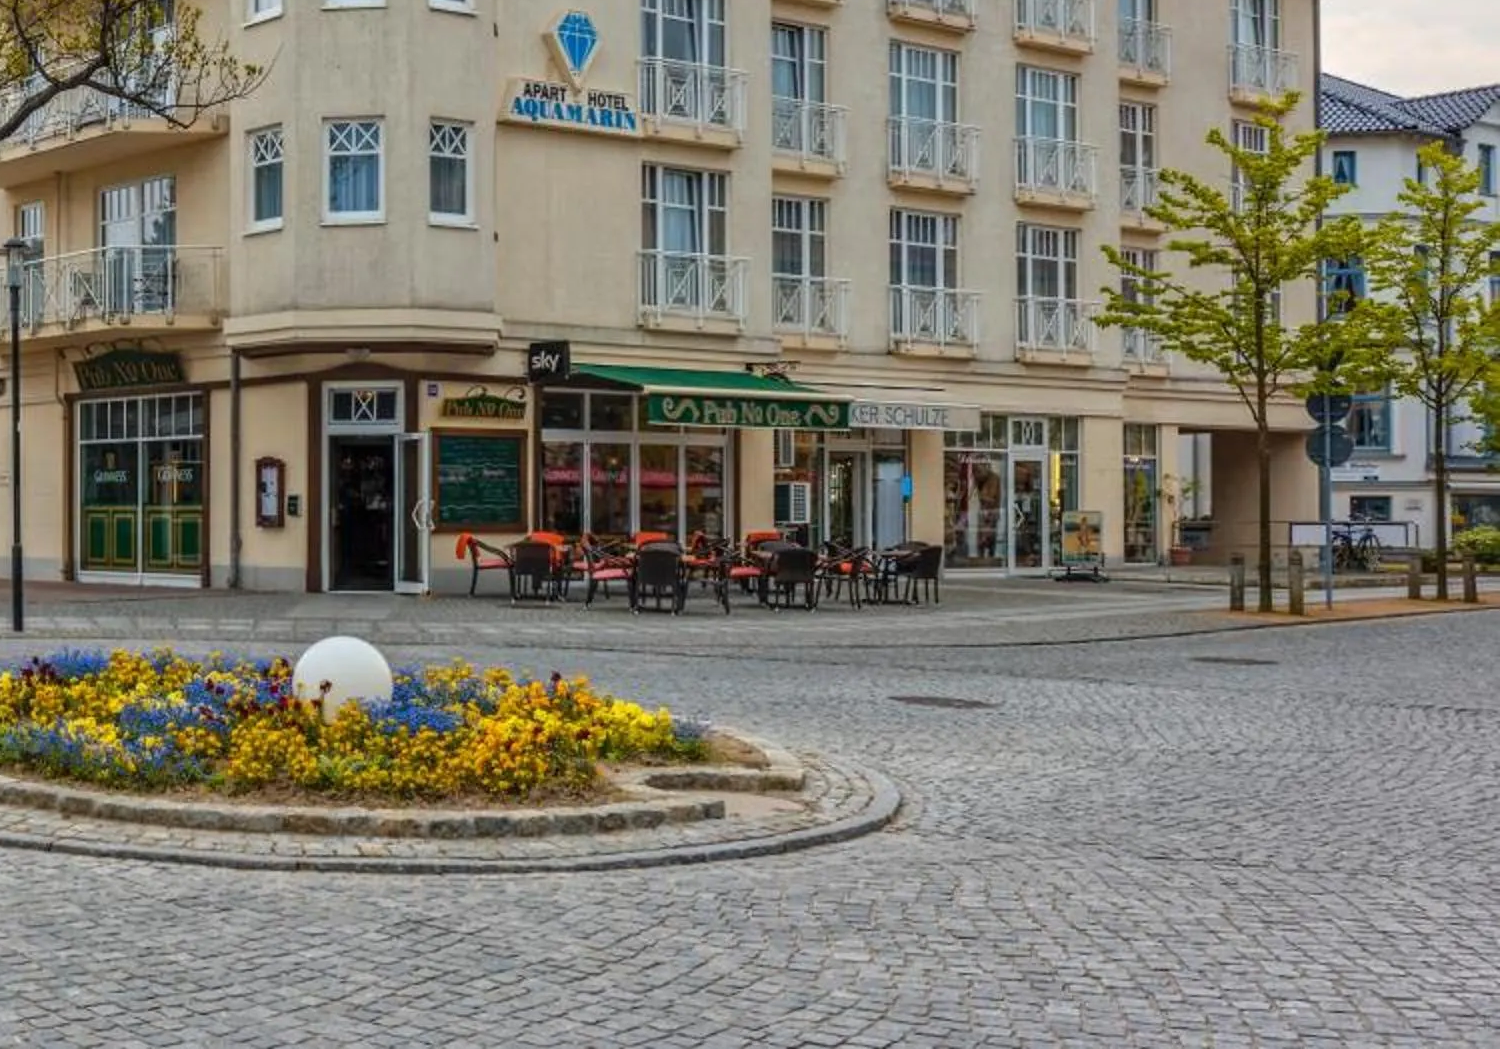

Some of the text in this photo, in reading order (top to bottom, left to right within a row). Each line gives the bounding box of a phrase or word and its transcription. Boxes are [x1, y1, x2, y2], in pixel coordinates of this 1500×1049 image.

[524, 83, 629, 111] APART HOTEL
[511, 97, 637, 130] AQUAMARIN
[531, 352, 562, 371] sky
[703, 401, 738, 424] Pub
[765, 403, 801, 426] One
[885, 407, 949, 427] SCHULZE
